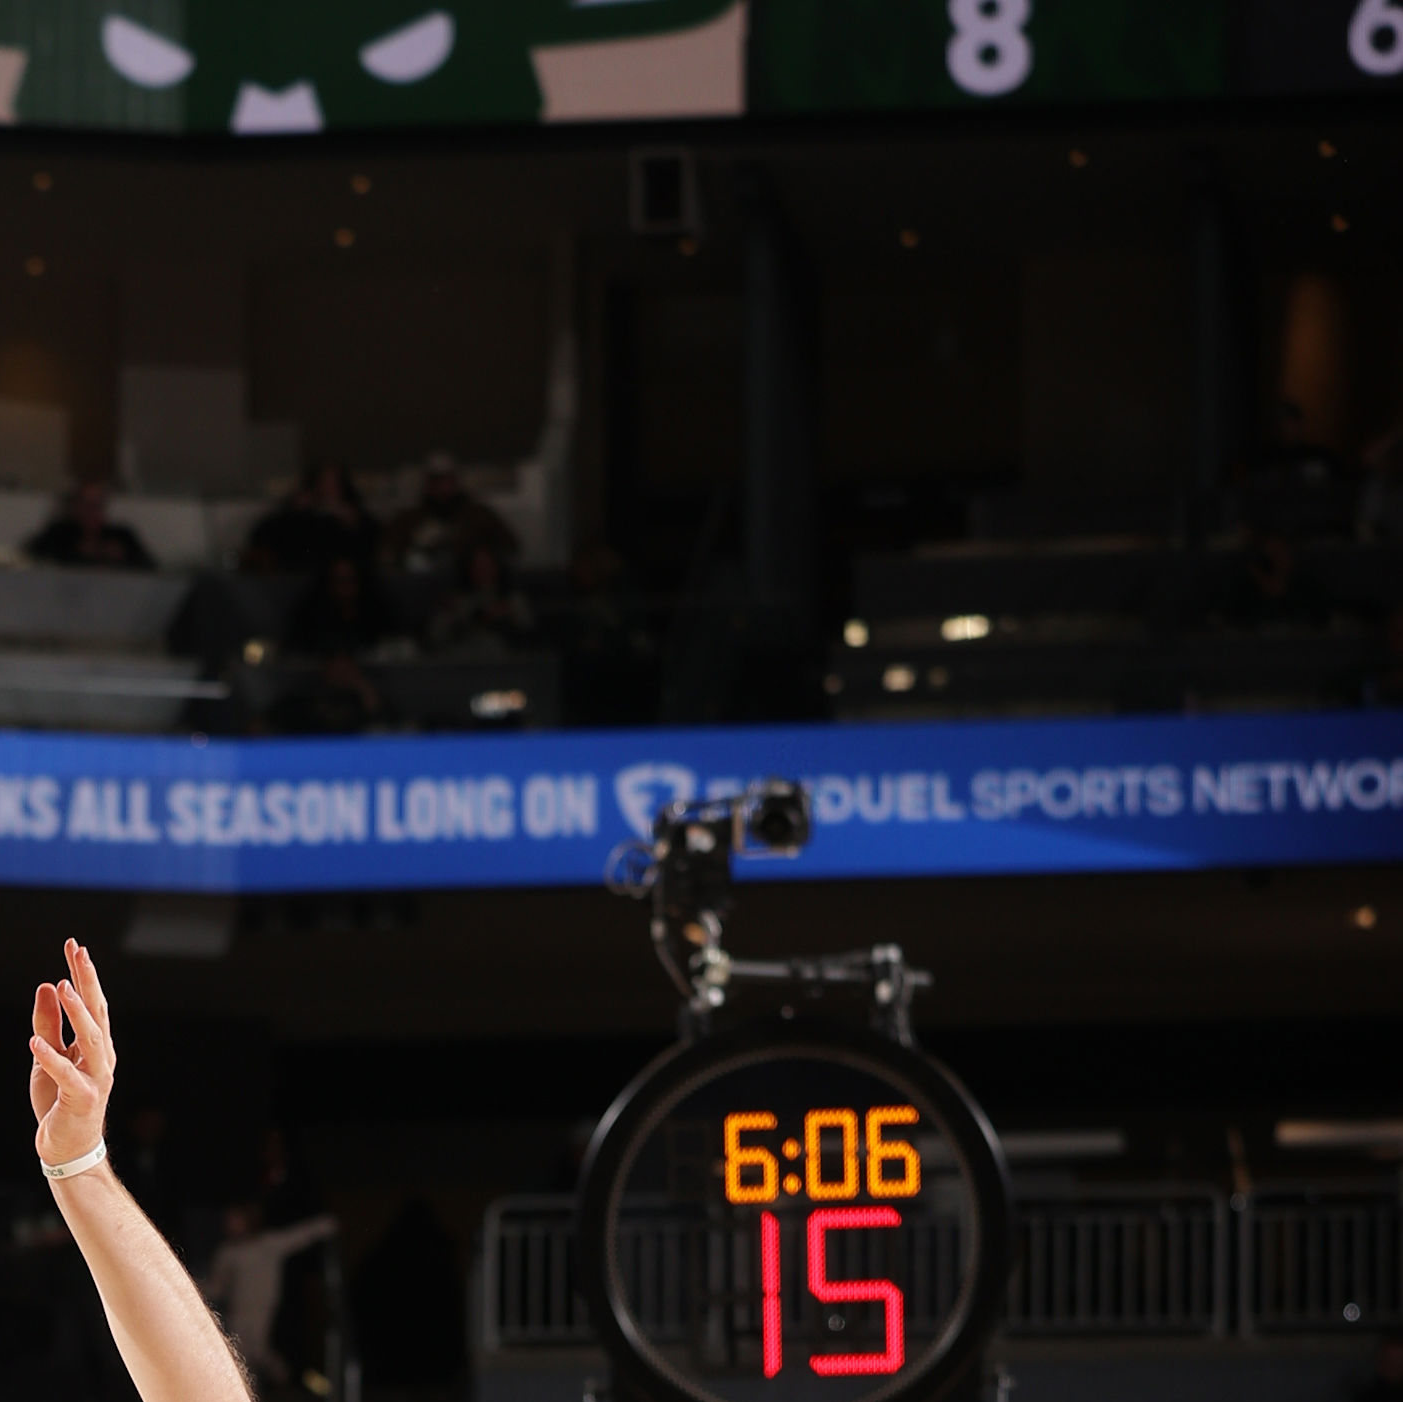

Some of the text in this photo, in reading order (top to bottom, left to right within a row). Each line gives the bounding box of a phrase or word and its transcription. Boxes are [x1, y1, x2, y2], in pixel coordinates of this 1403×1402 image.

[946, 0, 1032, 96] 8
[66, 778, 160, 843] ALL
[166, 779, 370, 846] SEASON
[375, 775, 514, 841] LONG
[522, 773, 600, 836] ON
[970, 763, 1184, 819] SPORTS
[725, 1105, 921, 1204] 6:06
[761, 1206, 905, 1379] 15
